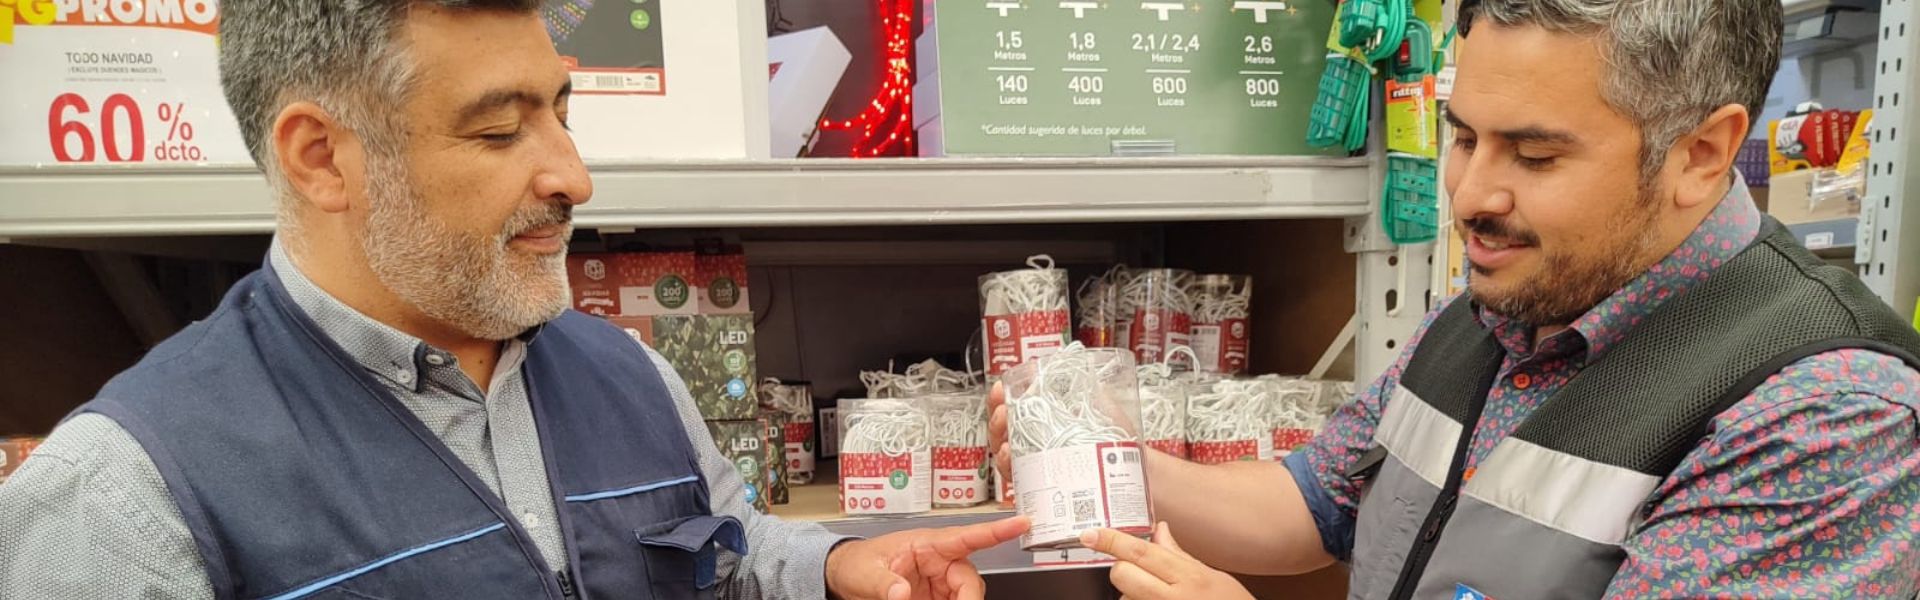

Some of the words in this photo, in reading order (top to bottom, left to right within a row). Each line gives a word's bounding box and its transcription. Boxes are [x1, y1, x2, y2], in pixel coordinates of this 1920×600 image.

[996, 31, 1022, 50] 1,5
[1069, 32, 1095, 50] 1,8
[1132, 33, 1155, 51] 2,1
[1171, 35, 1200, 53] 2,4
[1244, 36, 1273, 54] 2,6
[64, 52, 99, 63] TODO
[102, 53, 153, 63] NAVIDAD
[994, 51, 1026, 60] Metros
[1068, 52, 1099, 61] Metros
[1152, 54, 1183, 63] Metros
[1245, 55, 1275, 64] Metros
[996, 75, 1028, 92] 140
[1068, 76, 1103, 92] 400
[1152, 77, 1187, 94] 600
[1246, 79, 1279, 95] 800
[999, 95, 1028, 104] Luces
[1073, 96, 1101, 105] Luces
[1157, 97, 1185, 106] Luces
[1250, 98, 1277, 107] Luces
[48, 92, 145, 162] 60
[157, 102, 193, 141] %
[1028, 125, 1065, 137] sugerida
[1067, 125, 1079, 135] de
[1081, 125, 1103, 135] luces
[1105, 127, 1121, 136] por
[155, 141, 207, 161] dcto.
[719, 331, 747, 345] LED
[731, 437, 759, 451] LED
